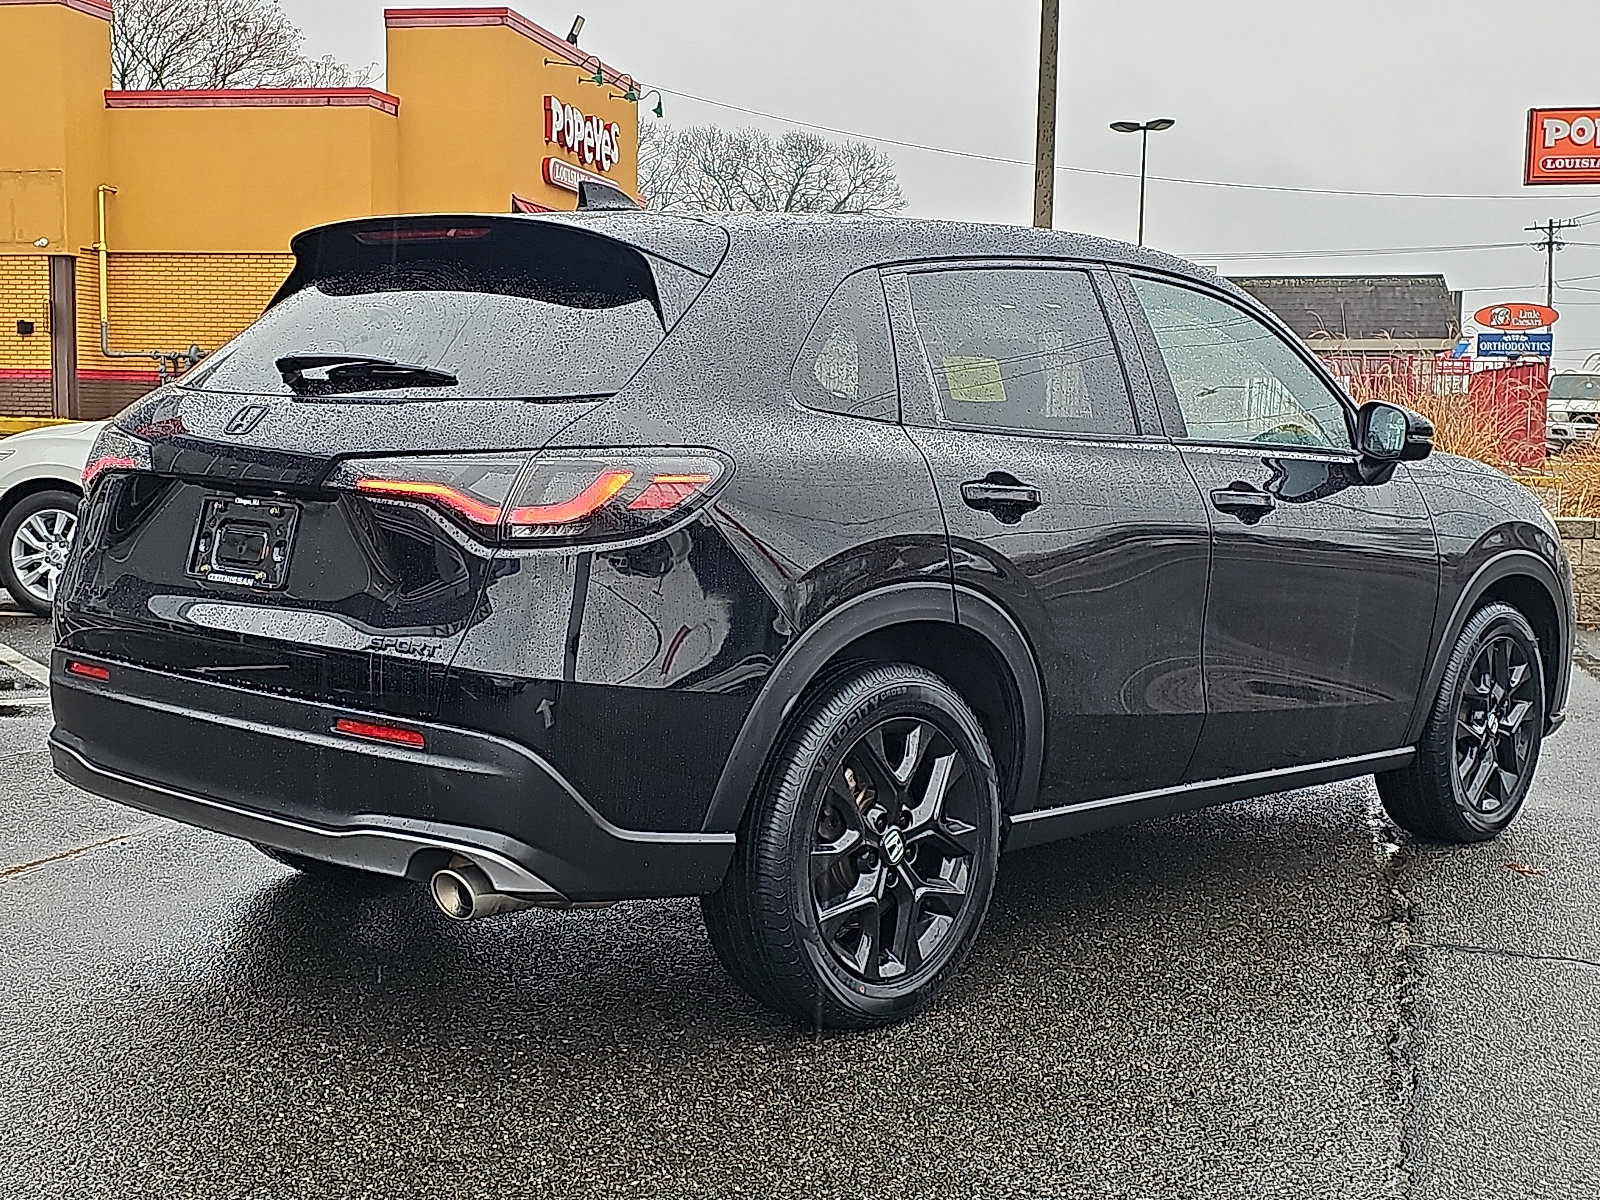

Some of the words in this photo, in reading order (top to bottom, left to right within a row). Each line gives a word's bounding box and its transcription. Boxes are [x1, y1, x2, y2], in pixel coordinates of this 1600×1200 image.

[1542, 116, 1600, 147] PO
[1480, 341, 1551, 352] ORTHODONTICS
[368, 636, 443, 658] SPORT
[814, 695, 879, 772] VELOCITY
